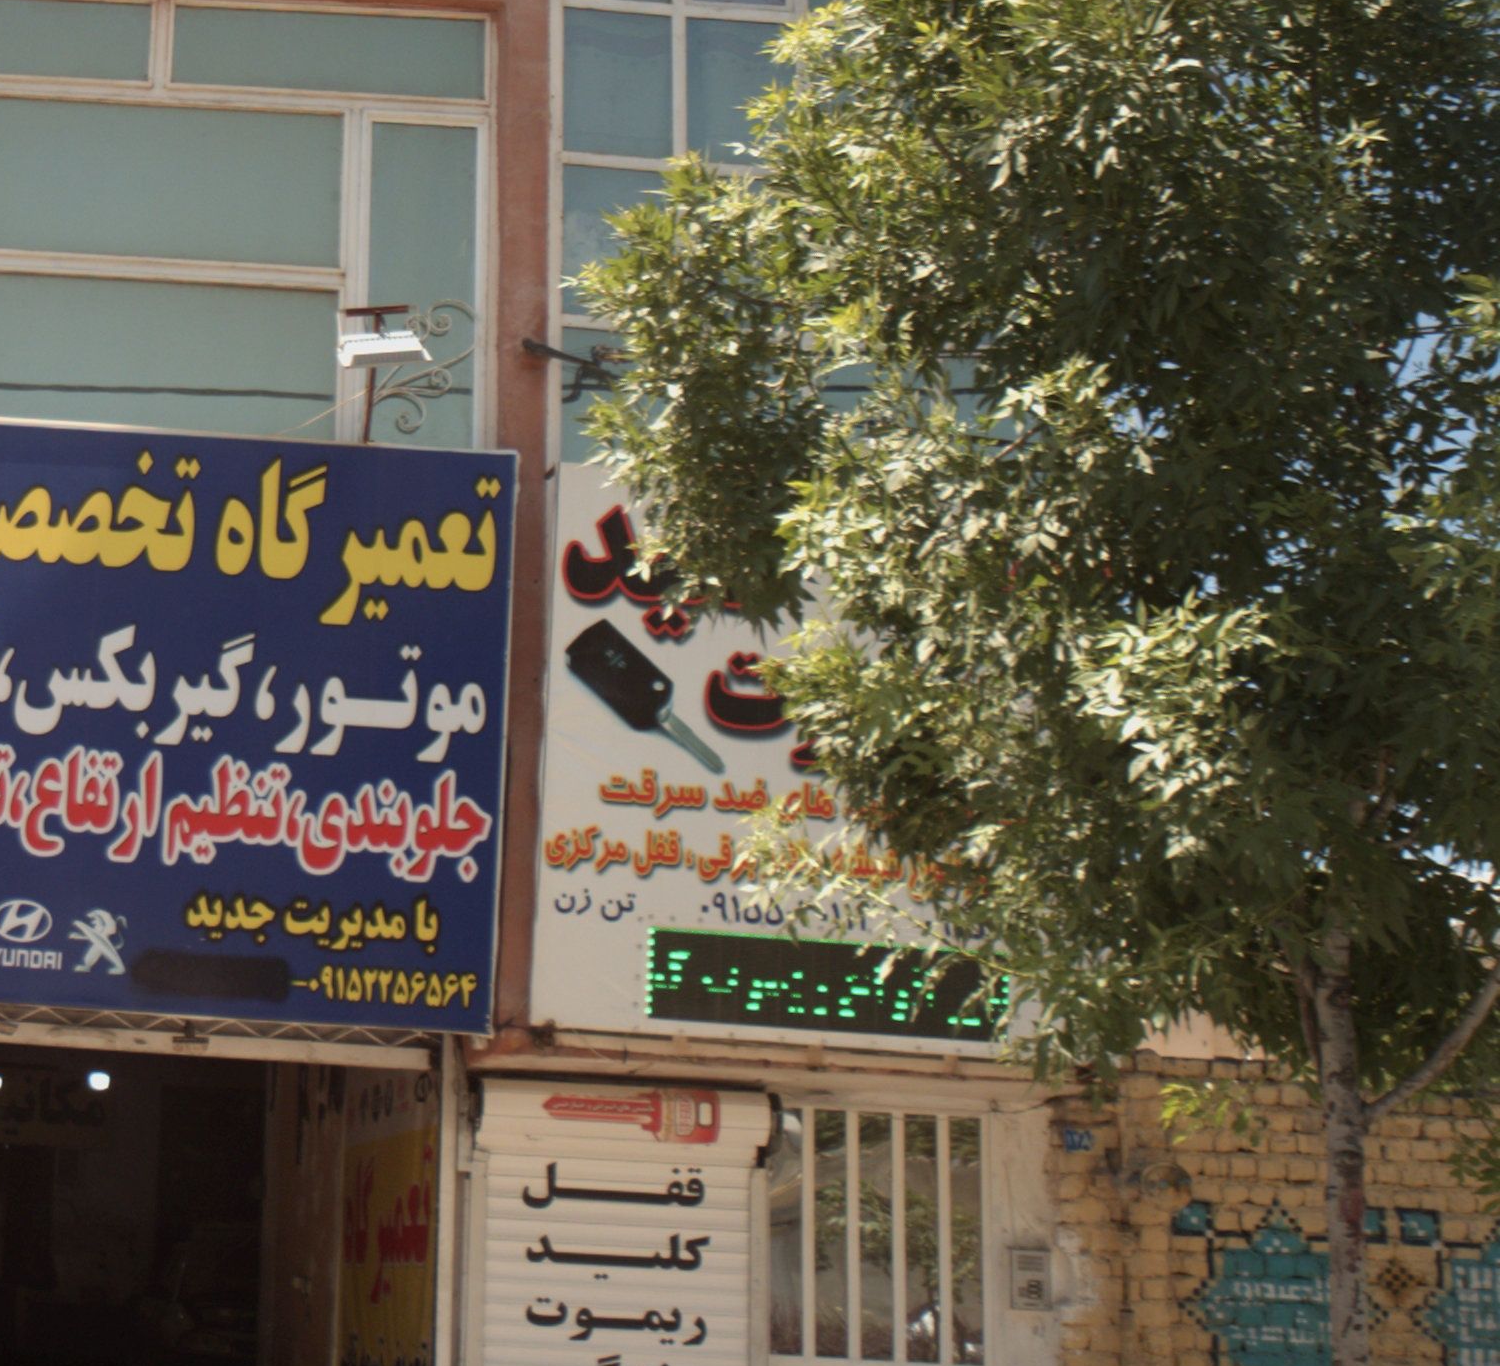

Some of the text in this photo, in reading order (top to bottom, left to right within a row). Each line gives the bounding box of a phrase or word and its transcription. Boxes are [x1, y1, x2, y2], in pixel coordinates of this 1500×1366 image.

[161, 754, 291, 866] تنظیم
[600, 768, 706, 818] سرقت
[713, 778, 769, 811] ضد
[544, 825, 628, 871] مرکزی
[633, 829, 681, 876] قفل
[185, 894, 440, 954] با مدیریت جدید
[522, 1161, 706, 1209] قفل
[526, 1233, 711, 1280] کلید
[525, 1296, 708, 1346] ریموت
